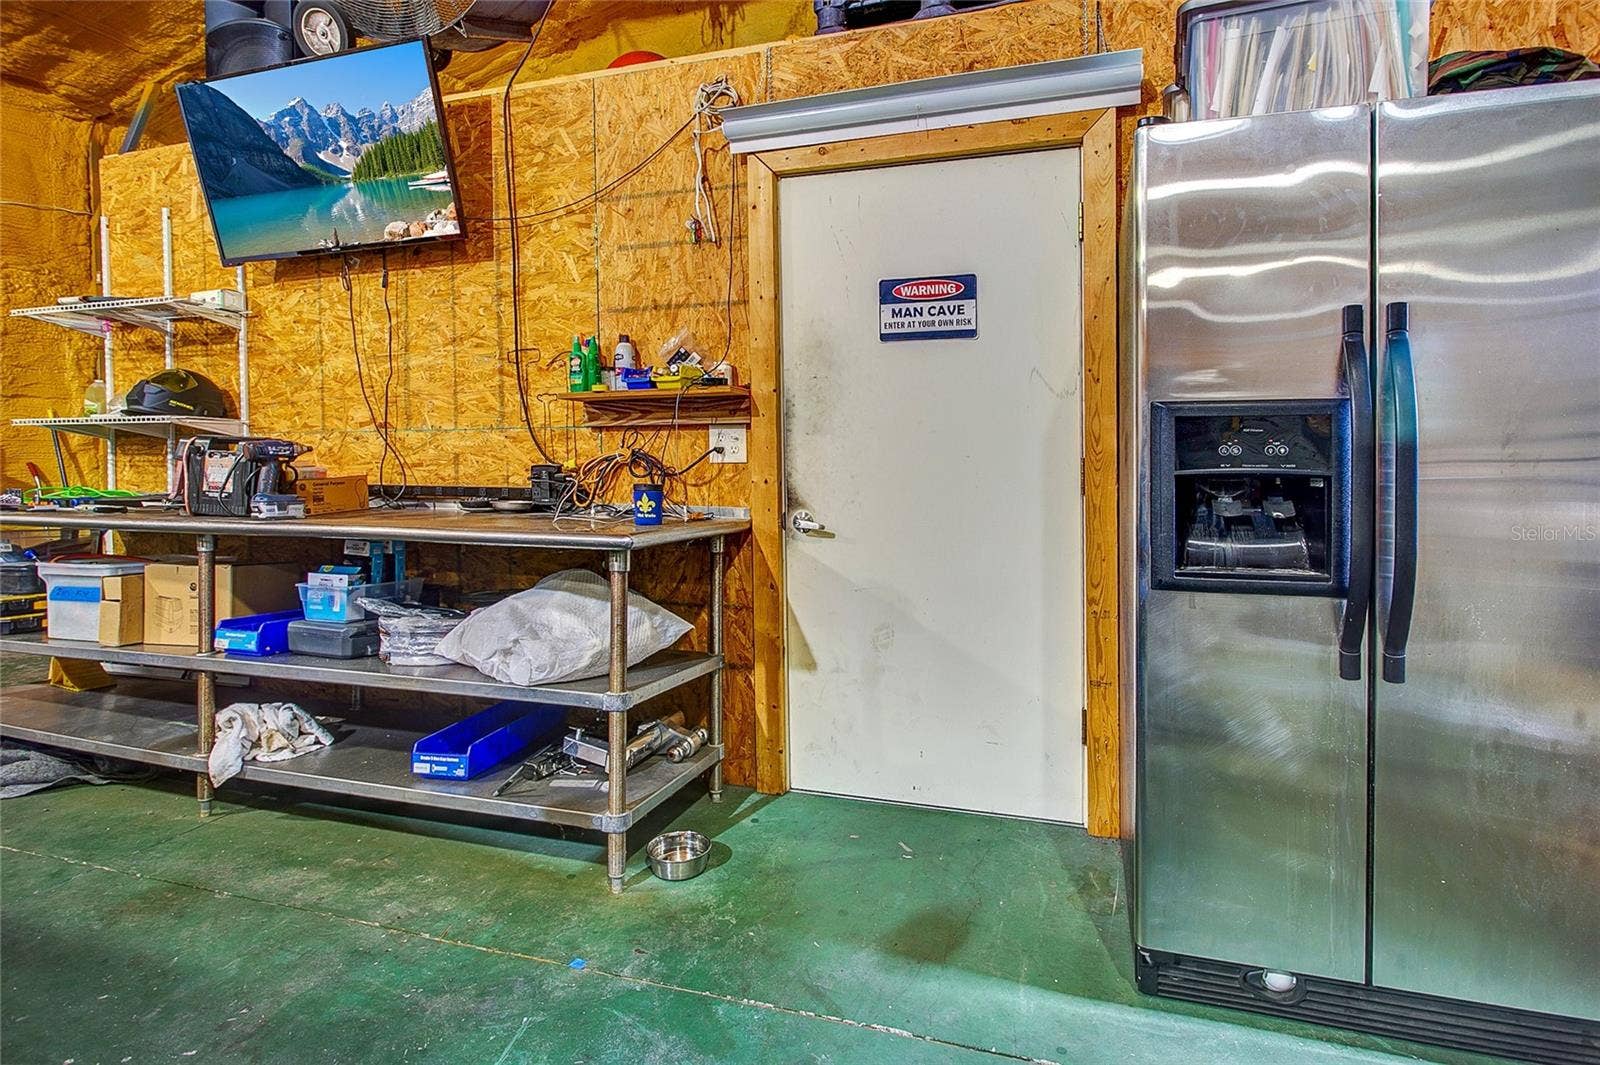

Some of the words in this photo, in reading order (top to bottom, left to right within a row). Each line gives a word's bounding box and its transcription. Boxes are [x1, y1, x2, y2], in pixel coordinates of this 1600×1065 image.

[900, 283, 956, 297] WARNING
[891, 306, 924, 319] MAN
[927, 304, 965, 317] CAVE
[884, 321, 906, 330] ENTER
[907, 320, 916, 328] AT
[917, 319, 936, 328] YOUR
[937, 318, 954, 327] OWN
[955, 318, 972, 326] RISK
